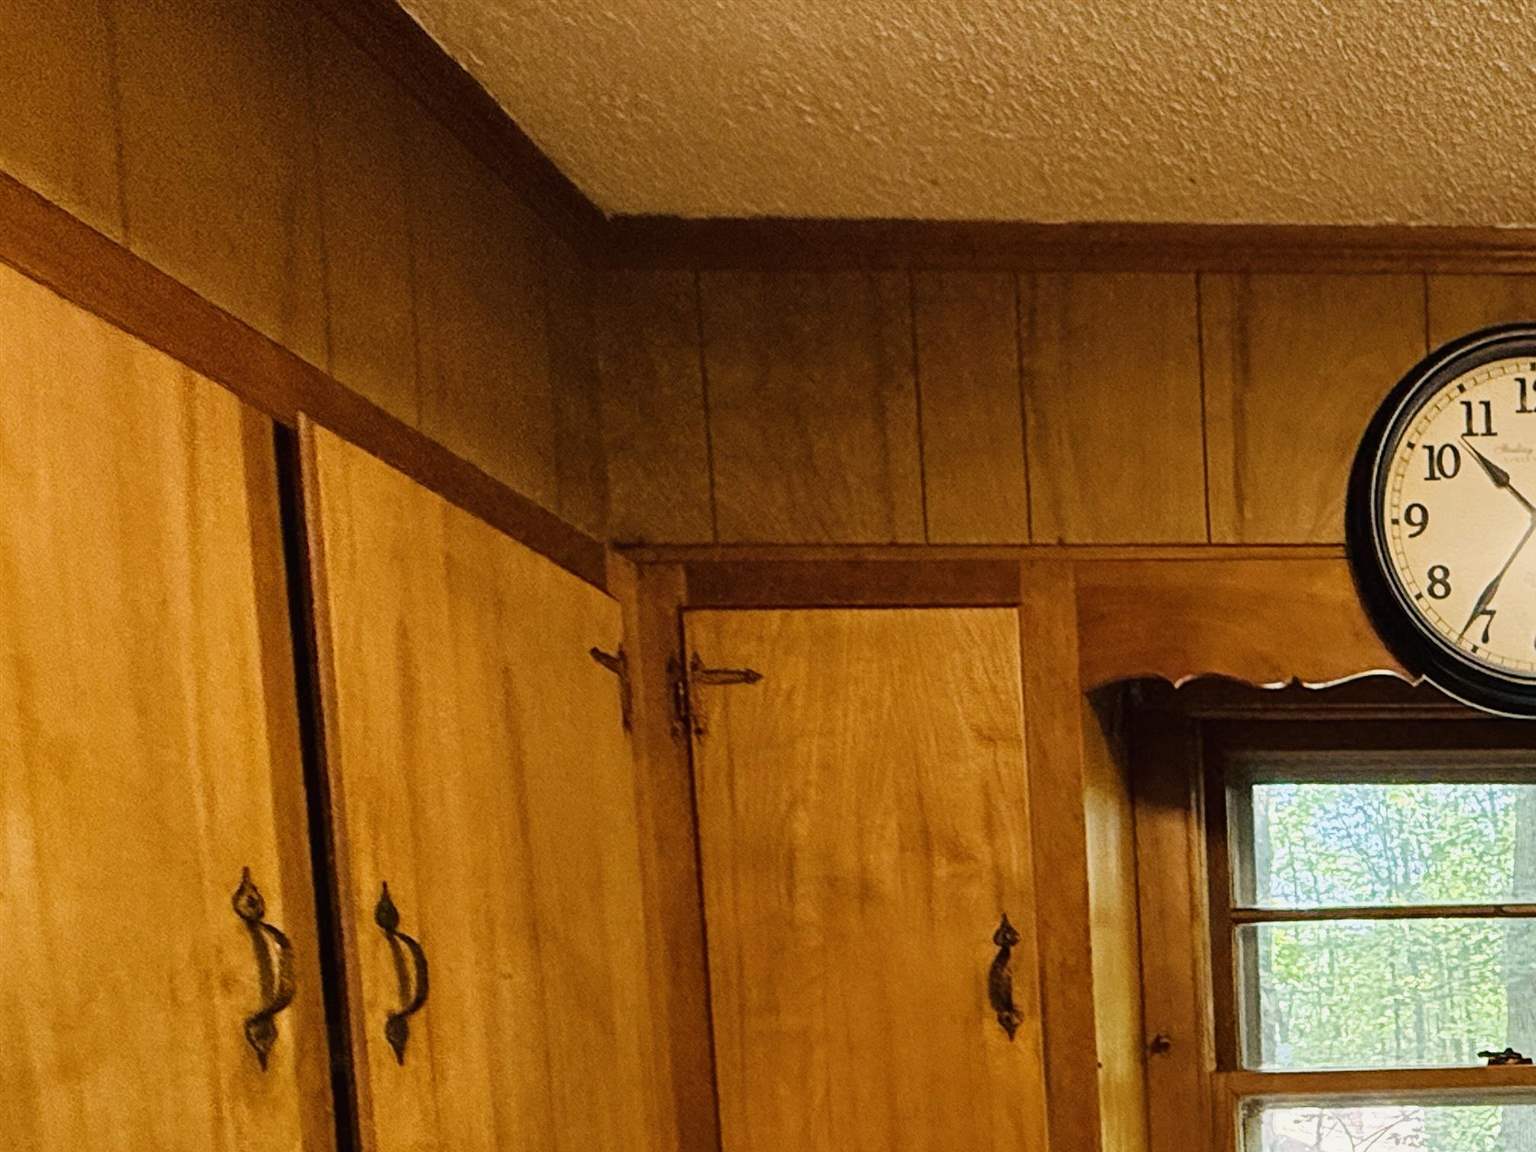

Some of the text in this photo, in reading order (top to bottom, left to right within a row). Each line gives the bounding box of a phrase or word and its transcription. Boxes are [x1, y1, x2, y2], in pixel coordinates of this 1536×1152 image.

[1459, 400, 1499, 437] 11
[1422, 443, 1462, 481] 10
[1404, 503, 1430, 538] 9
[1427, 565, 1452, 600] 8
[1475, 609, 1497, 644] 7
